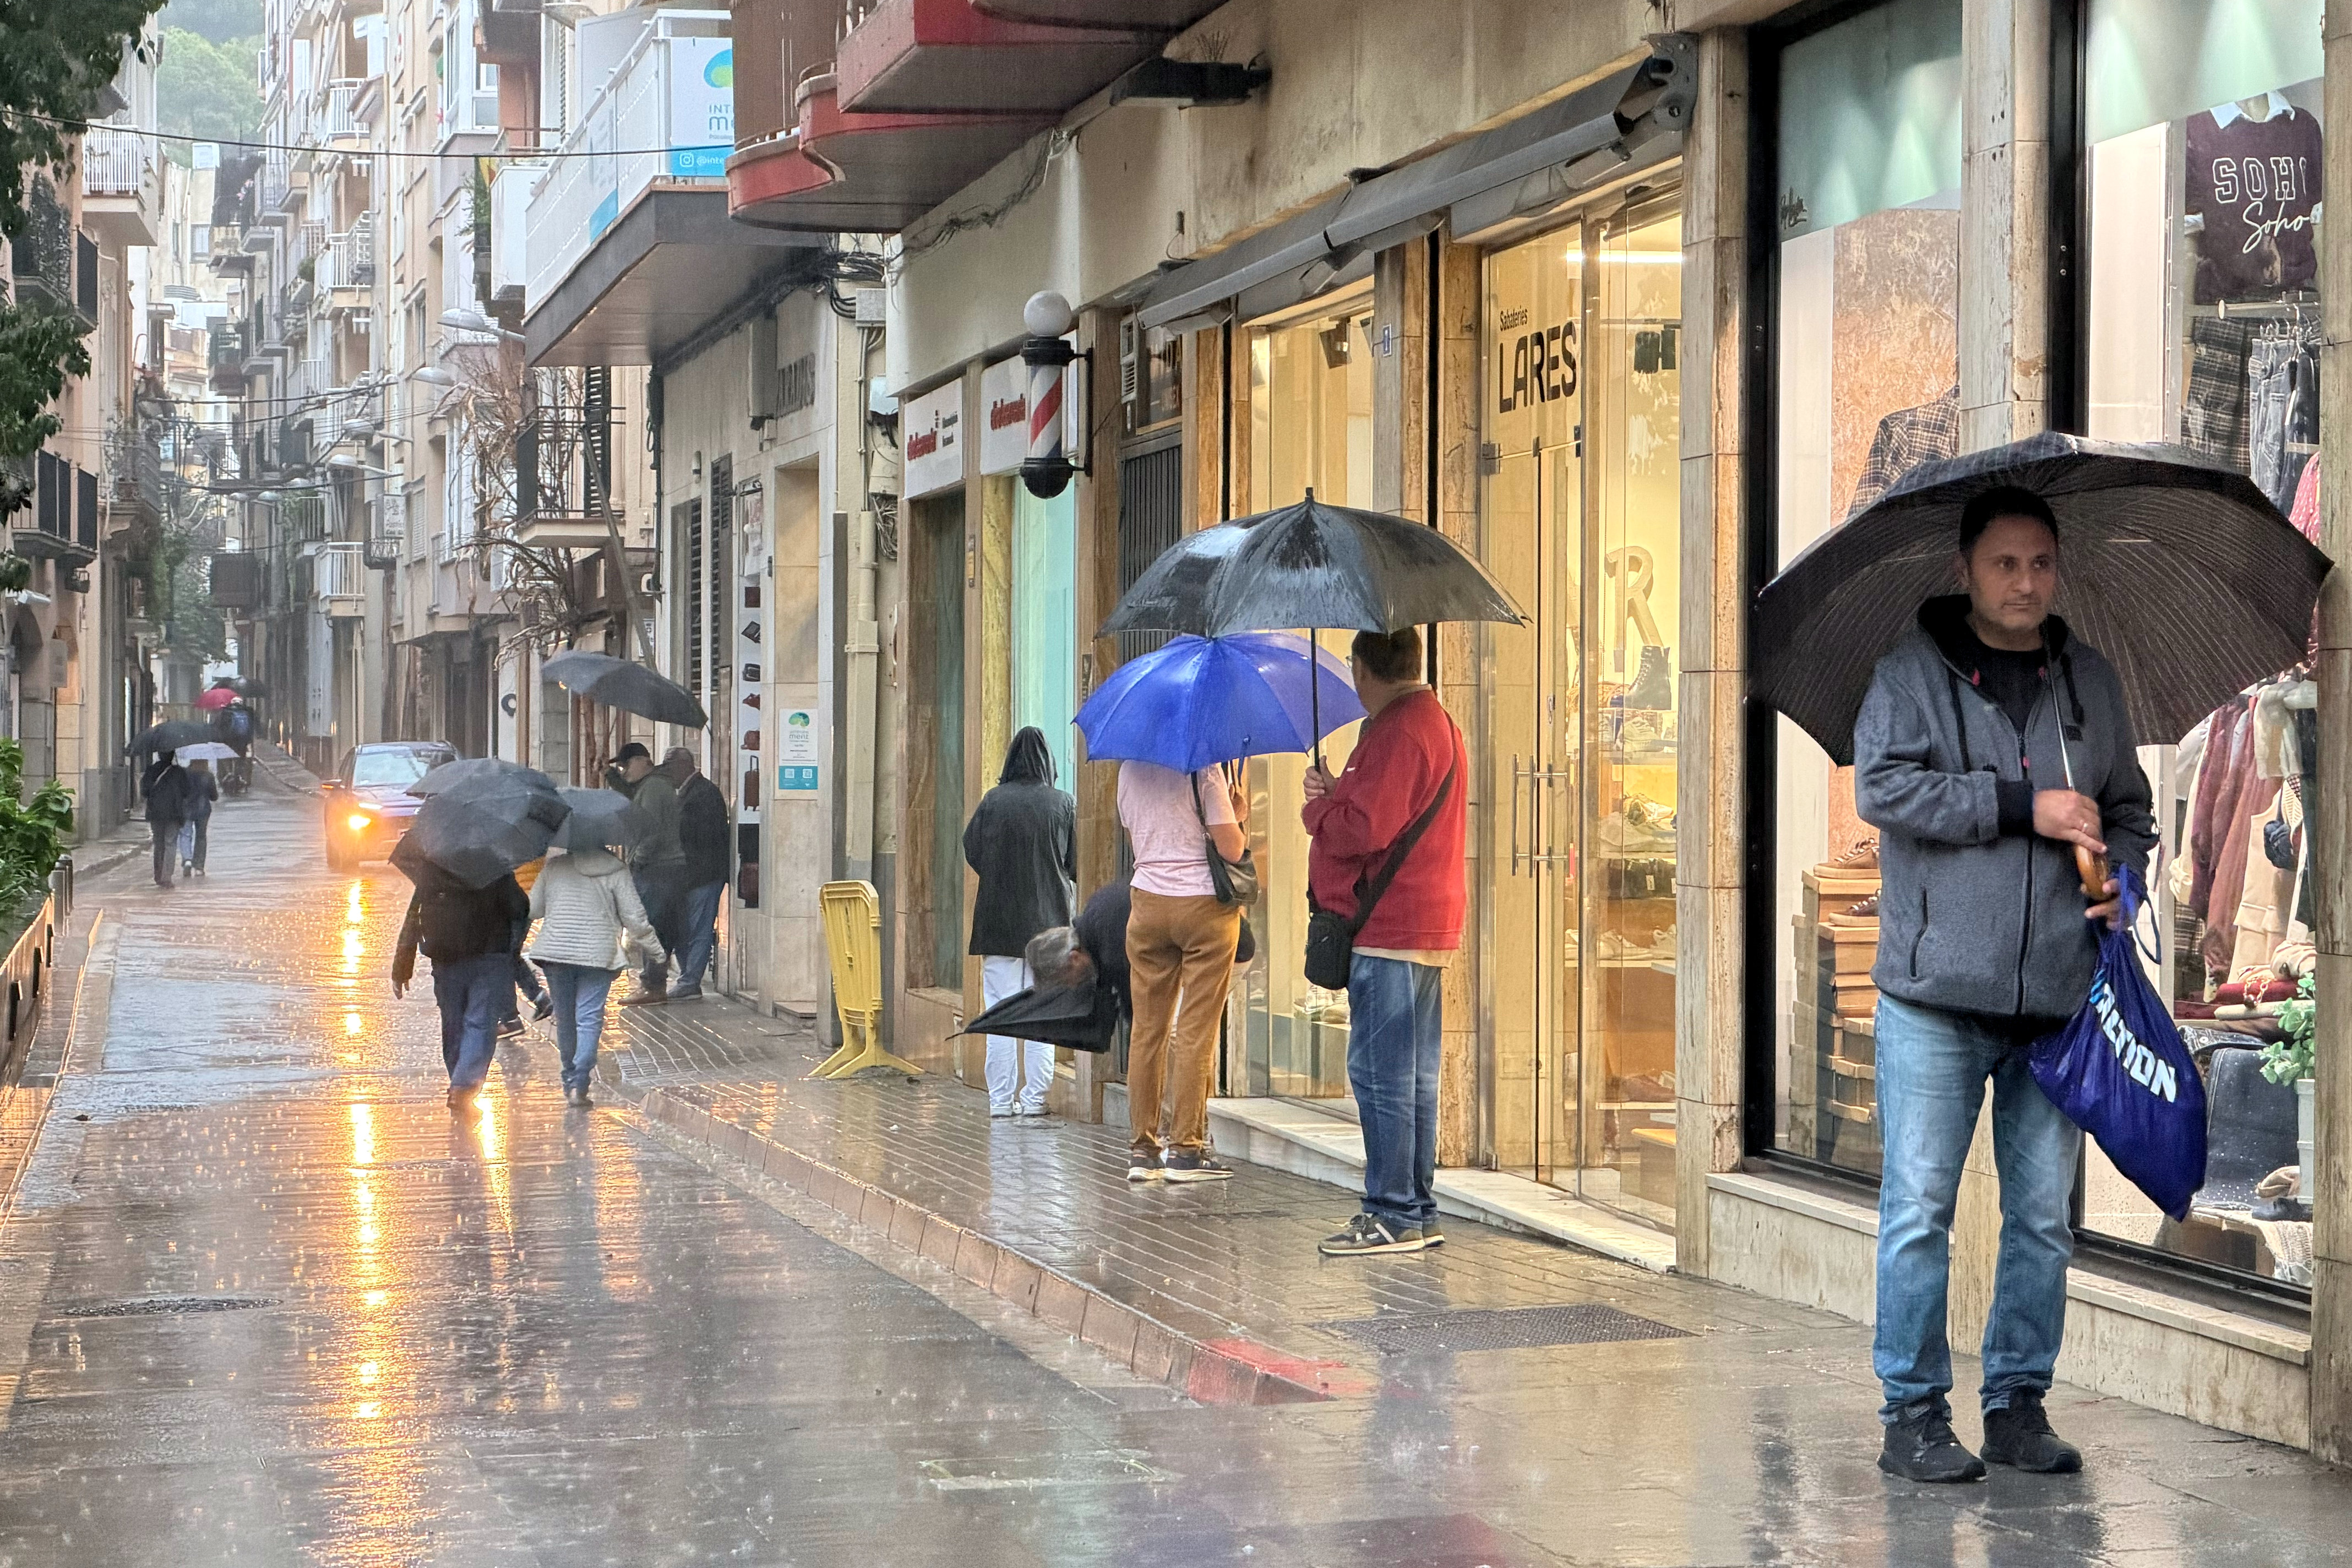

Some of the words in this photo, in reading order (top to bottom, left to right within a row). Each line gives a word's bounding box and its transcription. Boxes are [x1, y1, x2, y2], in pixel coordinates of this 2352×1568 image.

[709, 104, 733, 114] INT
[709, 116, 734, 130] m
[2242, 201, 2310, 254] Soho
[1500, 305, 1528, 331] Sabateries
[1499, 320, 1577, 413] LARES
[2095, 983, 2176, 1103] ACTION
